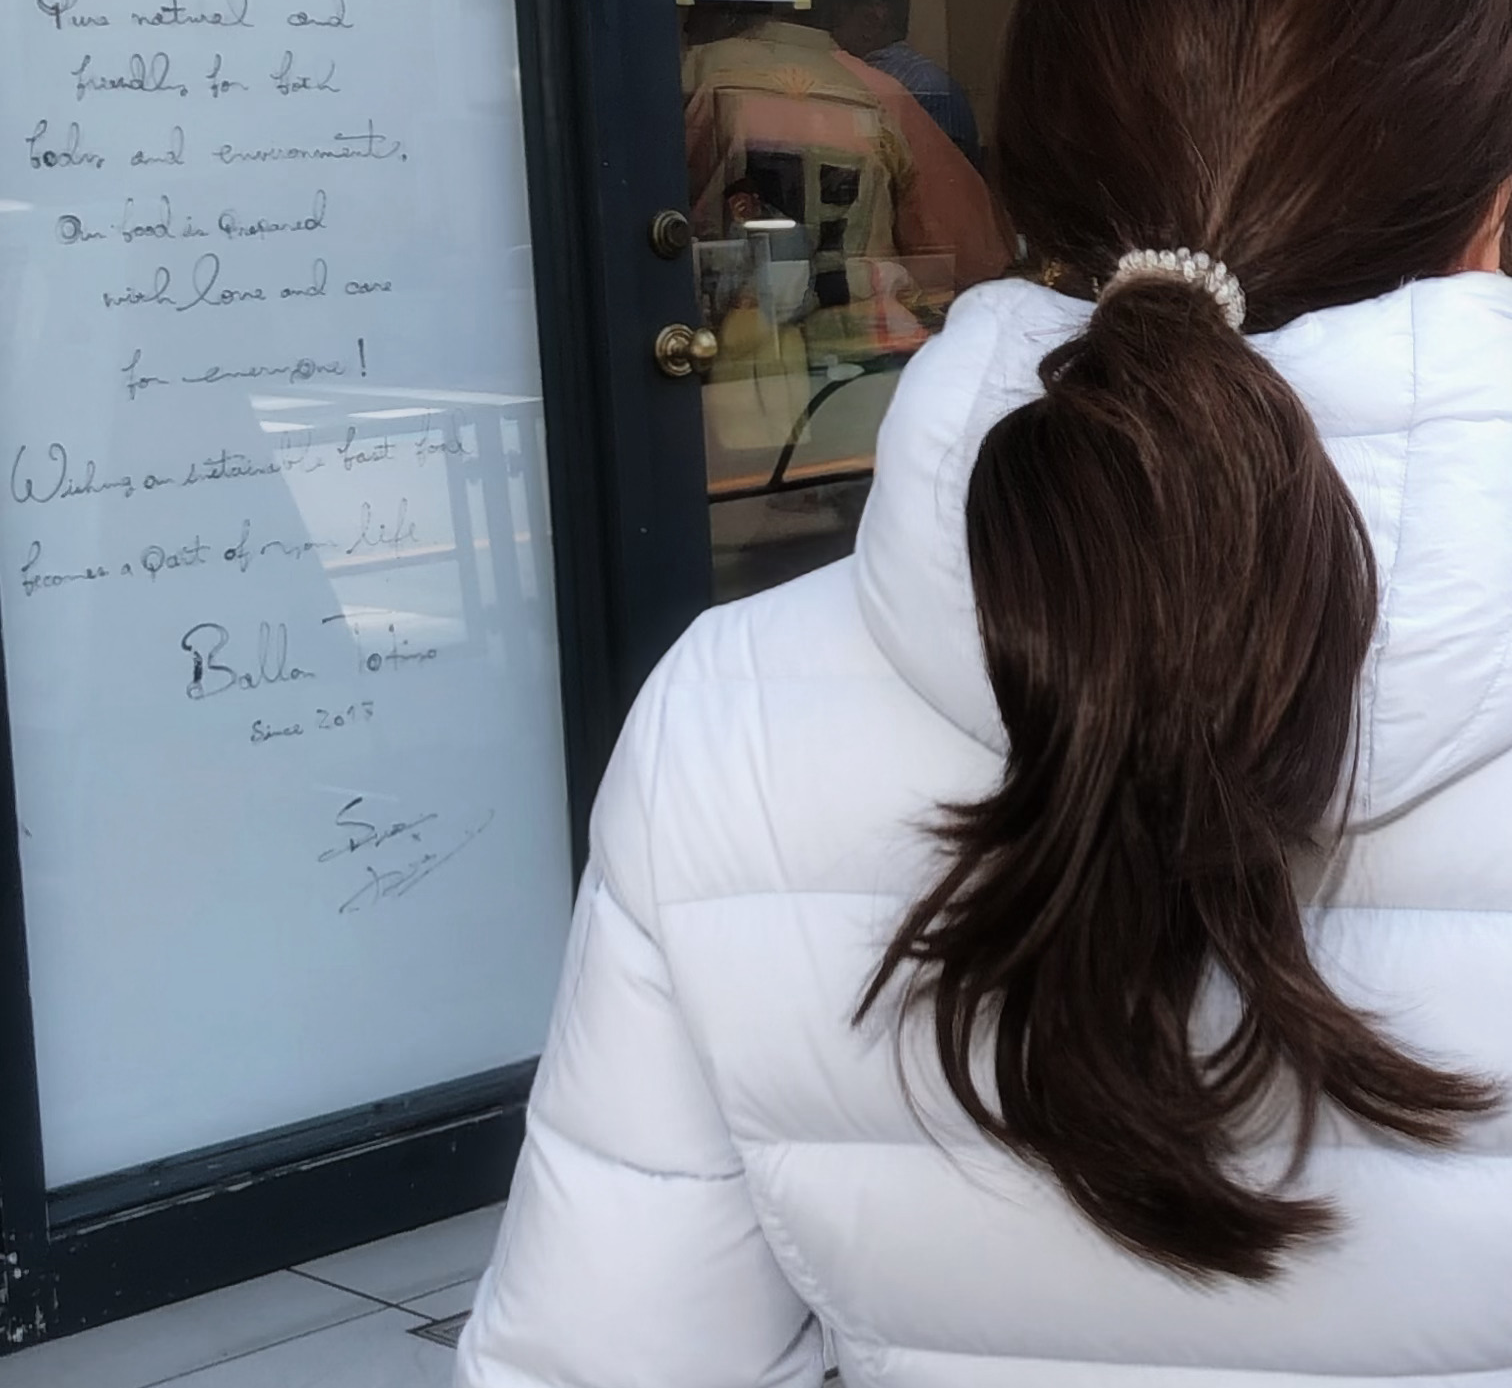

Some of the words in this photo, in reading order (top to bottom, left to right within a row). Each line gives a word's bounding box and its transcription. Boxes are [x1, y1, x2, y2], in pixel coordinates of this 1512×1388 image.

[205, 52, 249, 99] for
[130, 125, 185, 166] and
[120, 194, 176, 243] food
[183, 216, 209, 238] is
[102, 265, 177, 308] with
[176, 251, 267, 312] love
[279, 258, 328, 297] and
[343, 278, 393, 295] care
[121, 348, 170, 401] for
[119, 560, 133, 577] a
[223, 517, 253, 573] of
[181, 621, 317, 701] Ballon
[250, 718, 305, 747] Since
